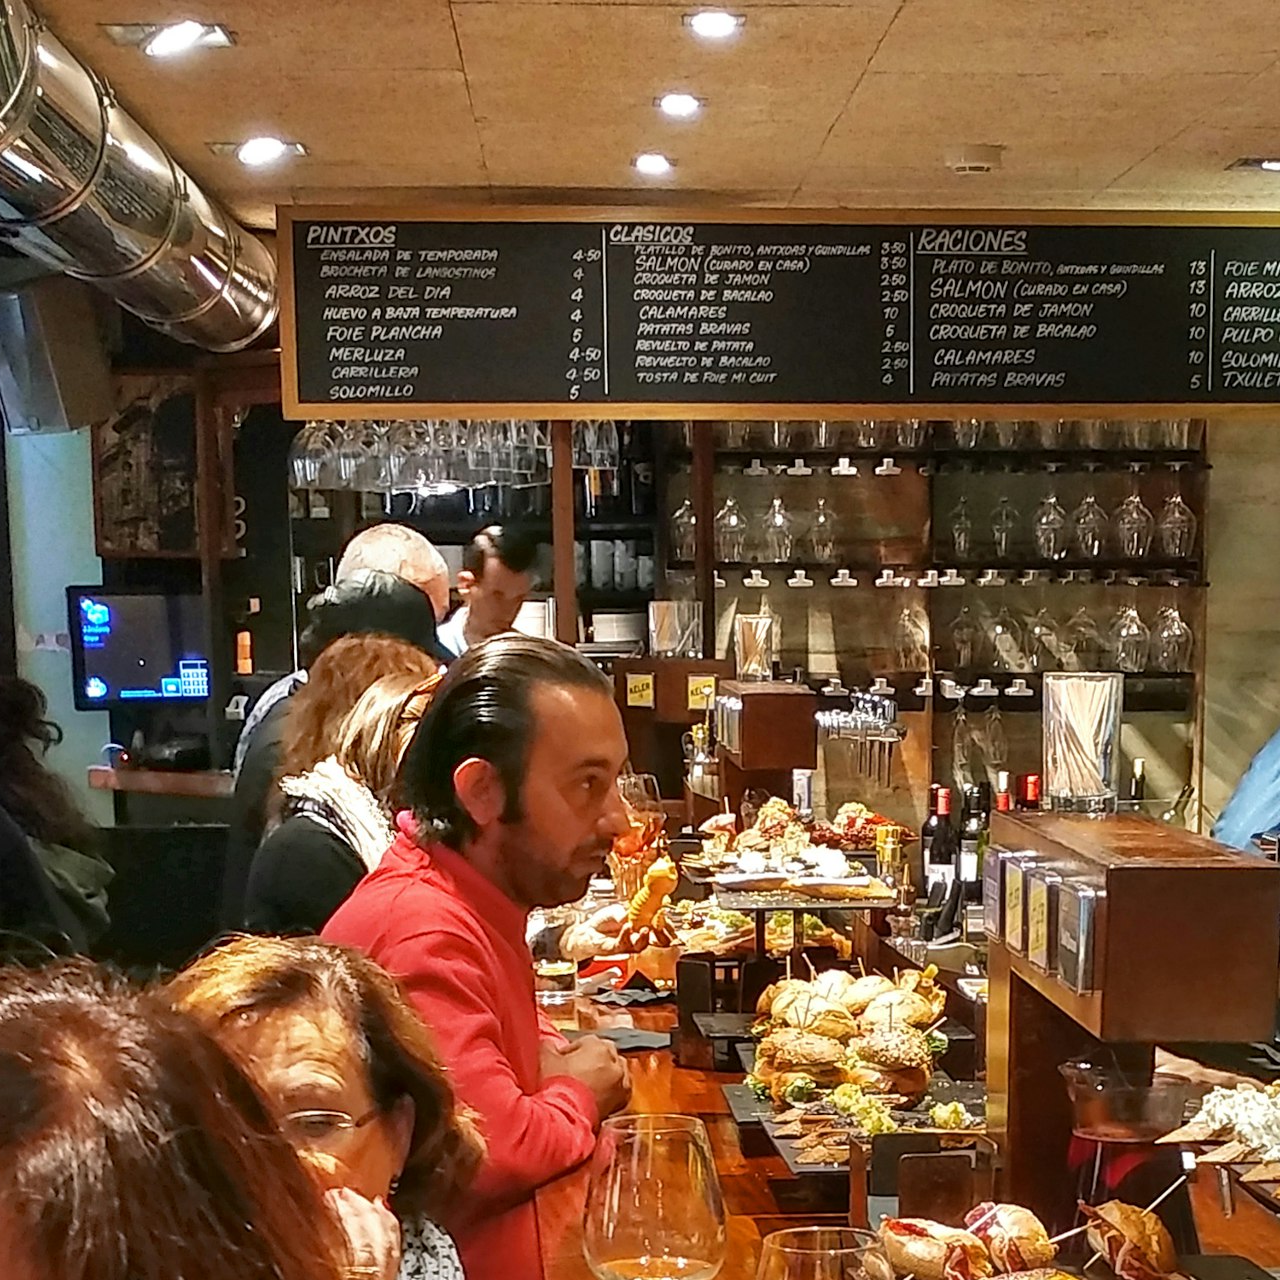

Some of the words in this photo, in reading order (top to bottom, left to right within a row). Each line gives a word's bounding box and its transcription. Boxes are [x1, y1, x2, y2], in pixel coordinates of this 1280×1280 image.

[307, 226, 396, 244] PINTXOS
[610, 225, 694, 242] CLASICOS
[918, 229, 1027, 251] RACIONES
[320, 250, 389, 261] ENSALADA
[397, 251, 412, 261] DE
[419, 250, 498, 261] TEMPORADA
[635, 245, 685, 255] PLATILLO
[691, 245, 706, 255] DE
[636, 256, 701, 271] SALMON
[704, 256, 753, 273] (CURADO
[758, 260, 771, 270] EN
[776, 257, 811, 273] CASA)
[932, 259, 974, 274] PLATO
[980, 261, 996, 274] DE
[1001, 261, 1053, 276] BONITO,
[1100, 265, 1107, 274] Y
[1189, 261, 1206, 274] 13
[1225, 261, 1258, 276] FOIE
[320, 266, 387, 278] BROCHETA
[417, 267, 496, 279] LANGOSTINOS
[573, 269, 583, 280] 4
[634, 274, 696, 285] CROQUETA
[705, 274, 719, 284] DE
[724, 274, 771, 285] JAMON
[325, 285, 380, 299] ARROZ
[388, 286, 419, 298] DEL
[425, 286, 451, 299] DIA
[571, 288, 583, 301] 4
[633, 290, 694, 301] CROQUETA
[700, 290, 716, 300] DE
[722, 290, 773, 301] BACALAO
[930, 280, 1008, 298] SALMON
[1013, 280, 1068, 298] (CURADO
[1072, 284, 1088, 295] EN
[1092, 280, 1127, 297] CASA)
[1189, 280, 1206, 294] 13
[323, 308, 367, 320] HUEVO
[372, 308, 381, 319] A
[386, 307, 419, 319] BAJA
[425, 307, 516, 318] TEMPERATURA
[571, 309, 582, 322] 4
[640, 306, 727, 319] CALAMARES
[883, 307, 899, 319] 10
[930, 304, 1006, 319] CROQUETA
[1013, 304, 1031, 317] DE
[1039, 303, 1094, 317] JAMON
[1189, 303, 1206, 317] 10
[327, 327, 364, 341] FOIE
[371, 326, 442, 339] PLANCHA
[573, 329, 582, 343] 5
[637, 323, 693, 335] PATATAS
[700, 323, 751, 335] BRAVAS
[930, 325, 1006, 339] CROQUETA
[1013, 326, 1029, 338] DE
[1036, 325, 1097, 338] BACALAO
[1189, 326, 1205, 339] 10
[1222, 328, 1273, 343] PULPO
[635, 341, 690, 352] REVUELTO
[694, 342, 708, 351] DE
[712, 341, 753, 351] PATATA
[330, 348, 405, 361] MERLUZA
[635, 356, 696, 367] REVUELTO
[701, 357, 714, 367] DE
[719, 356, 771, 367] BACALAO
[934, 350, 1036, 365] CALAMARES
[1188, 351, 1204, 364] 10
[332, 367, 419, 378] CARRILLERA
[637, 373, 678, 383] TOSTA
[683, 373, 699, 383] DE
[703, 373, 727, 384] FOIE
[731, 373, 746, 383] MI
[749, 373, 777, 383] CUIT
[883, 373, 894, 385] 4
[932, 373, 997, 387] PATATAS
[1004, 373, 1066, 386] BRAVAS
[1190, 375, 1201, 389] 5
[330, 385, 413, 399] SOLOMILLO
[570, 386, 580, 399] 5
